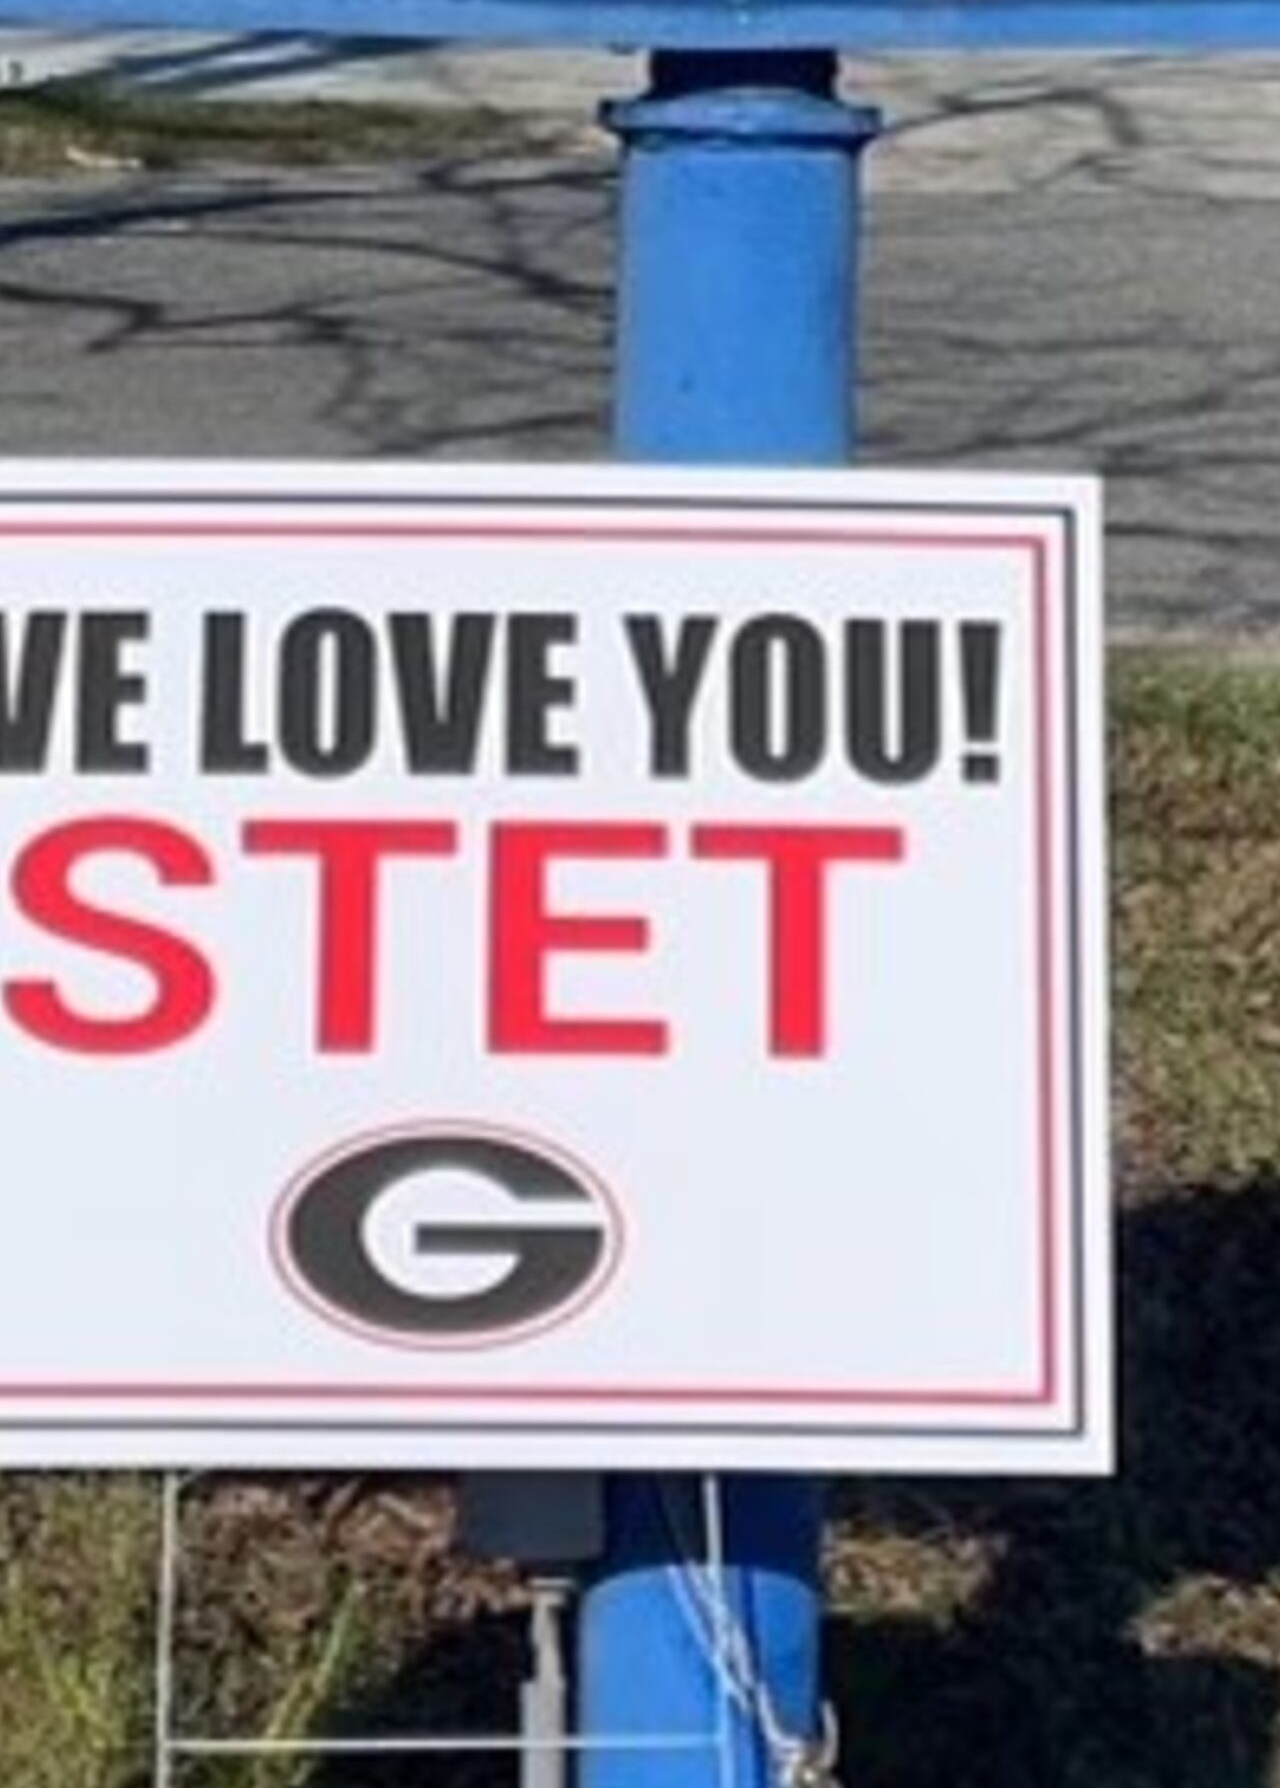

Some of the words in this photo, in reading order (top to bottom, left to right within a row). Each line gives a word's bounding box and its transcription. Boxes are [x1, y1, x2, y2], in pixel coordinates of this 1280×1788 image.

[198, 606, 581, 779] LOVE
[622, 612, 1004, 786] YOU!
[0, 812, 905, 1061] STET
[283, 1133, 607, 1336] G
